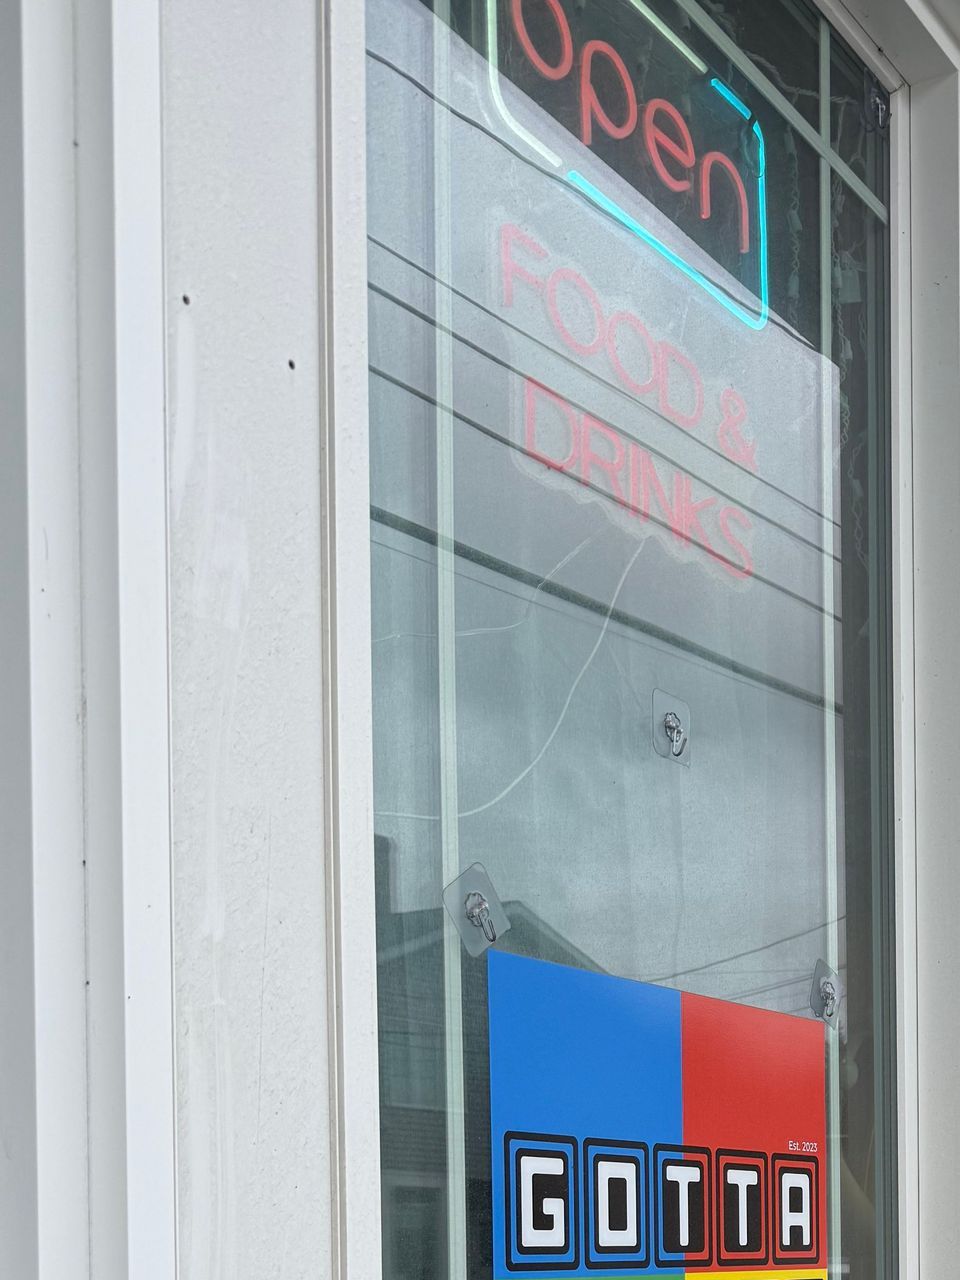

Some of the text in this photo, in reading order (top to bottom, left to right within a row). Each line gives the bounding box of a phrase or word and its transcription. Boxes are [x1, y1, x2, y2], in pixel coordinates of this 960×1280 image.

[501, 223, 758, 473] FOOD &
[524, 375, 754, 580] DRINKS
[520, 1155, 811, 1248] GOTTA
[788, 1140, 818, 1153] Est. 2023
